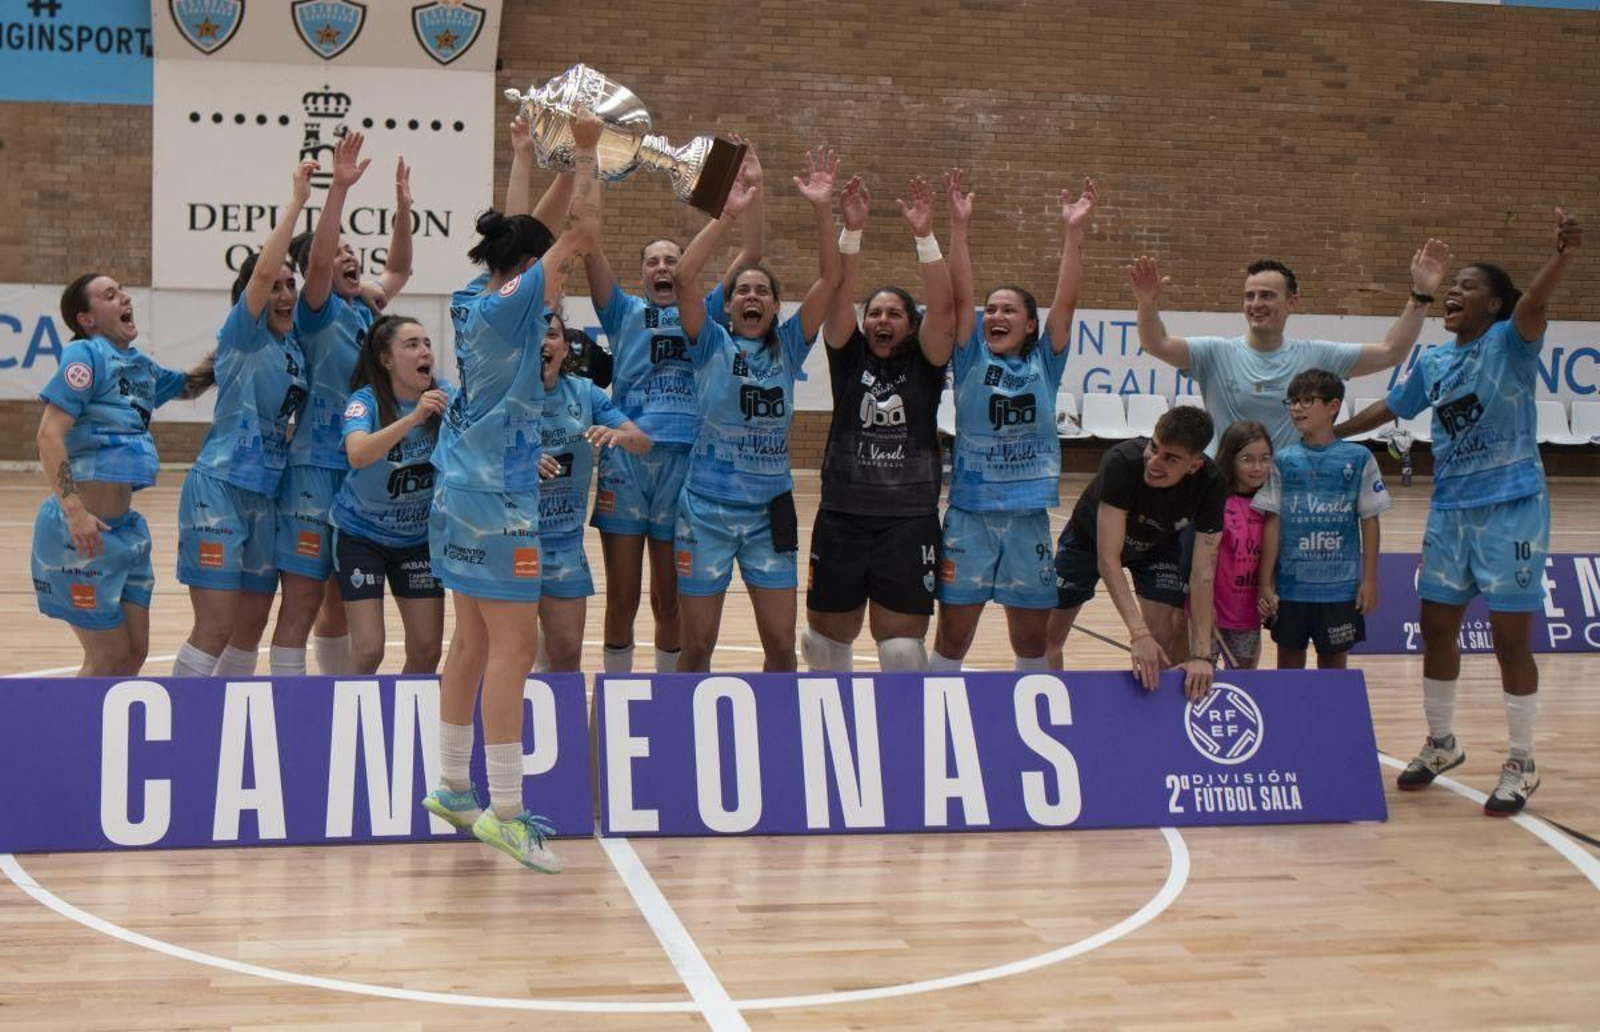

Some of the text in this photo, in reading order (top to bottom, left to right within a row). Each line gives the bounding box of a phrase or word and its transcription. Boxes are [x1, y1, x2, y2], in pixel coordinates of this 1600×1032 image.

[0, 22, 151, 55] GINSPORT
[989, 393, 1036, 431] jba
[1307, 492, 1353, 513] Varela
[921, 545, 935, 564] 14
[1514, 541, 1531, 560] 10
[405, 561, 431, 570] ABAN
[1166, 769, 1297, 813] 2ª DIVISIÓN
[1194, 783, 1302, 812] FÚTBOL SALA
